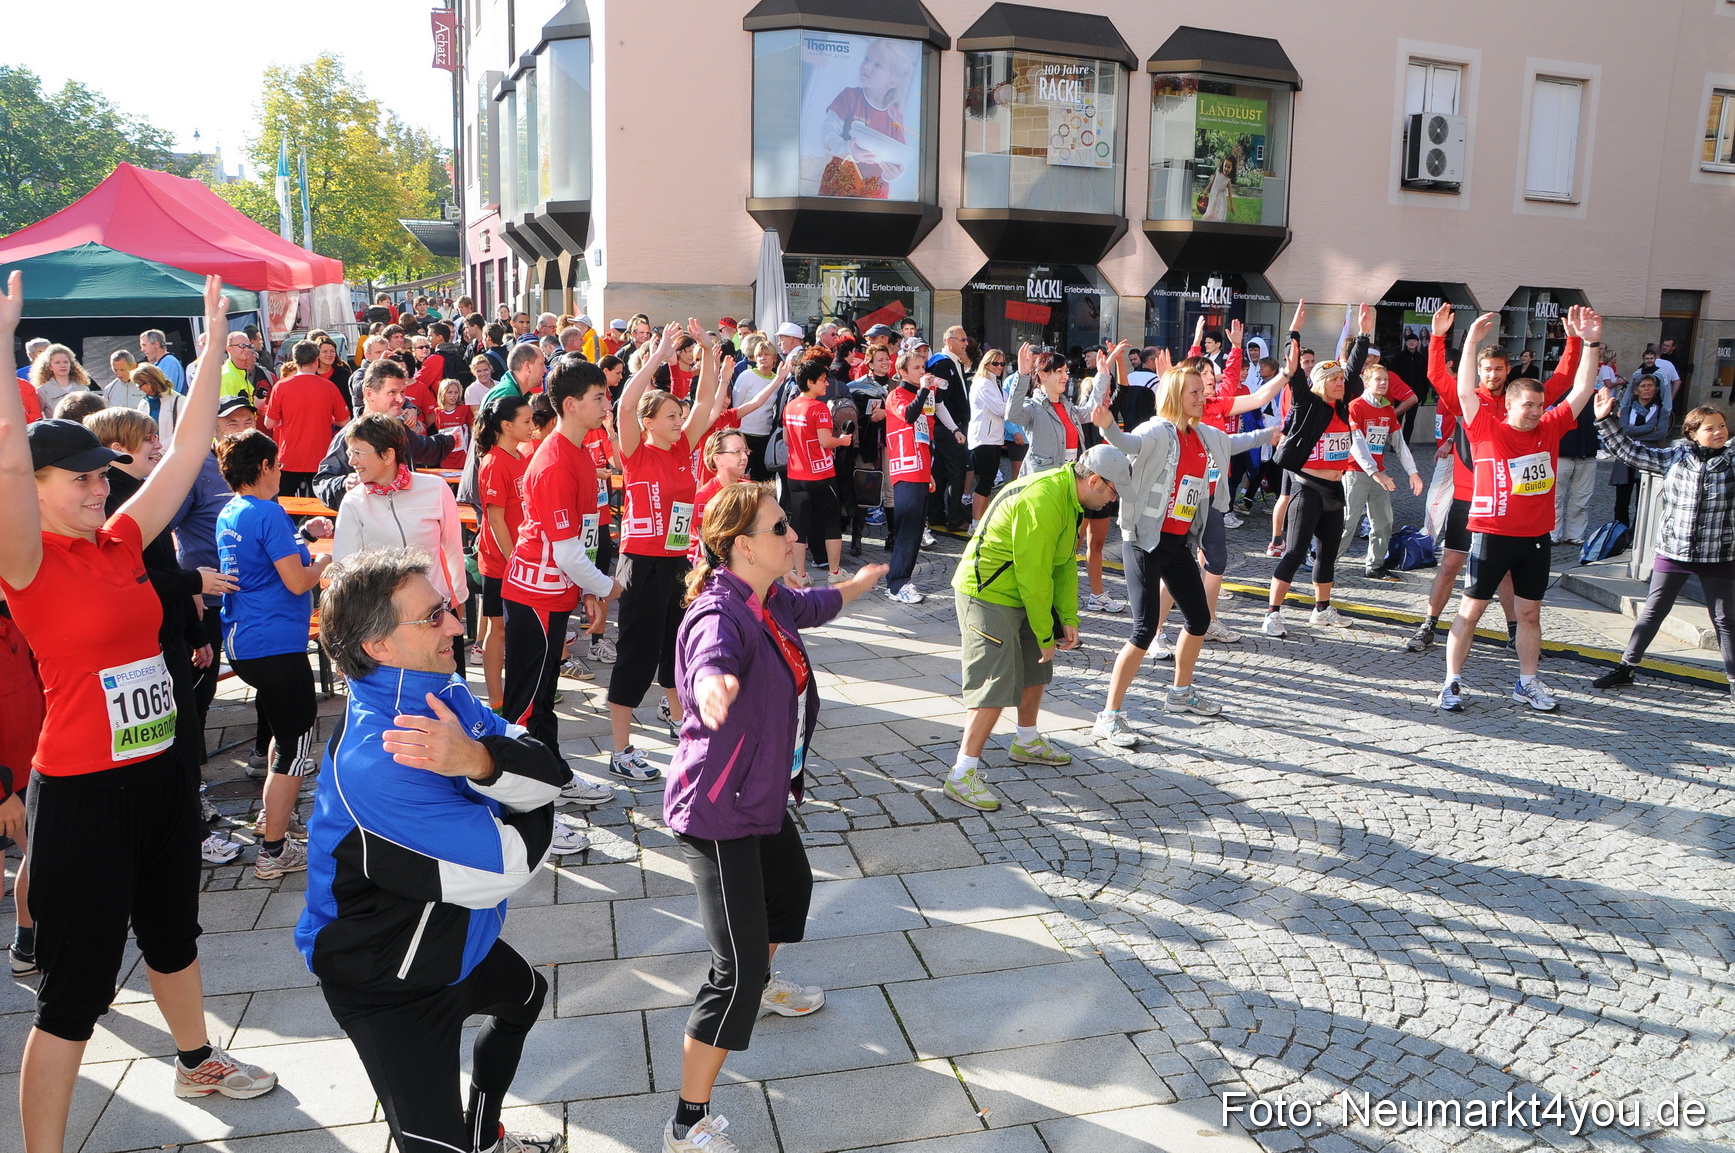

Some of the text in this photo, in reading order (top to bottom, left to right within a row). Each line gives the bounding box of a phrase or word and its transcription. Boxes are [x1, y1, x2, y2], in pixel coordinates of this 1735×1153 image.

[435, 21, 449, 65] Achatz
[804, 38, 850, 53] Thomas
[1044, 65, 1089, 76] 100 Jahre
[1039, 77, 1081, 103] RACKL
[1200, 99, 1263, 121] LANDLUST
[830, 276, 870, 298] RACKL
[872, 283, 922, 293] Erlebnishaus.
[972, 279, 1107, 299] Willkommen im RACKL Erlebnishaus.
[1153, 289, 1190, 298] Willkommen
[1201, 286, 1232, 305] RACKL
[1233, 293, 1272, 301] Erlebnishaus.
[1535, 302, 1559, 318] RACKL
[1522, 463, 1547, 481] 439
[1524, 480, 1547, 492] Guido
[651, 481, 664, 536] MAX BÖGL
[1497, 490, 1508, 516] MAX
[116, 665, 157, 682] PFLEIDERER
